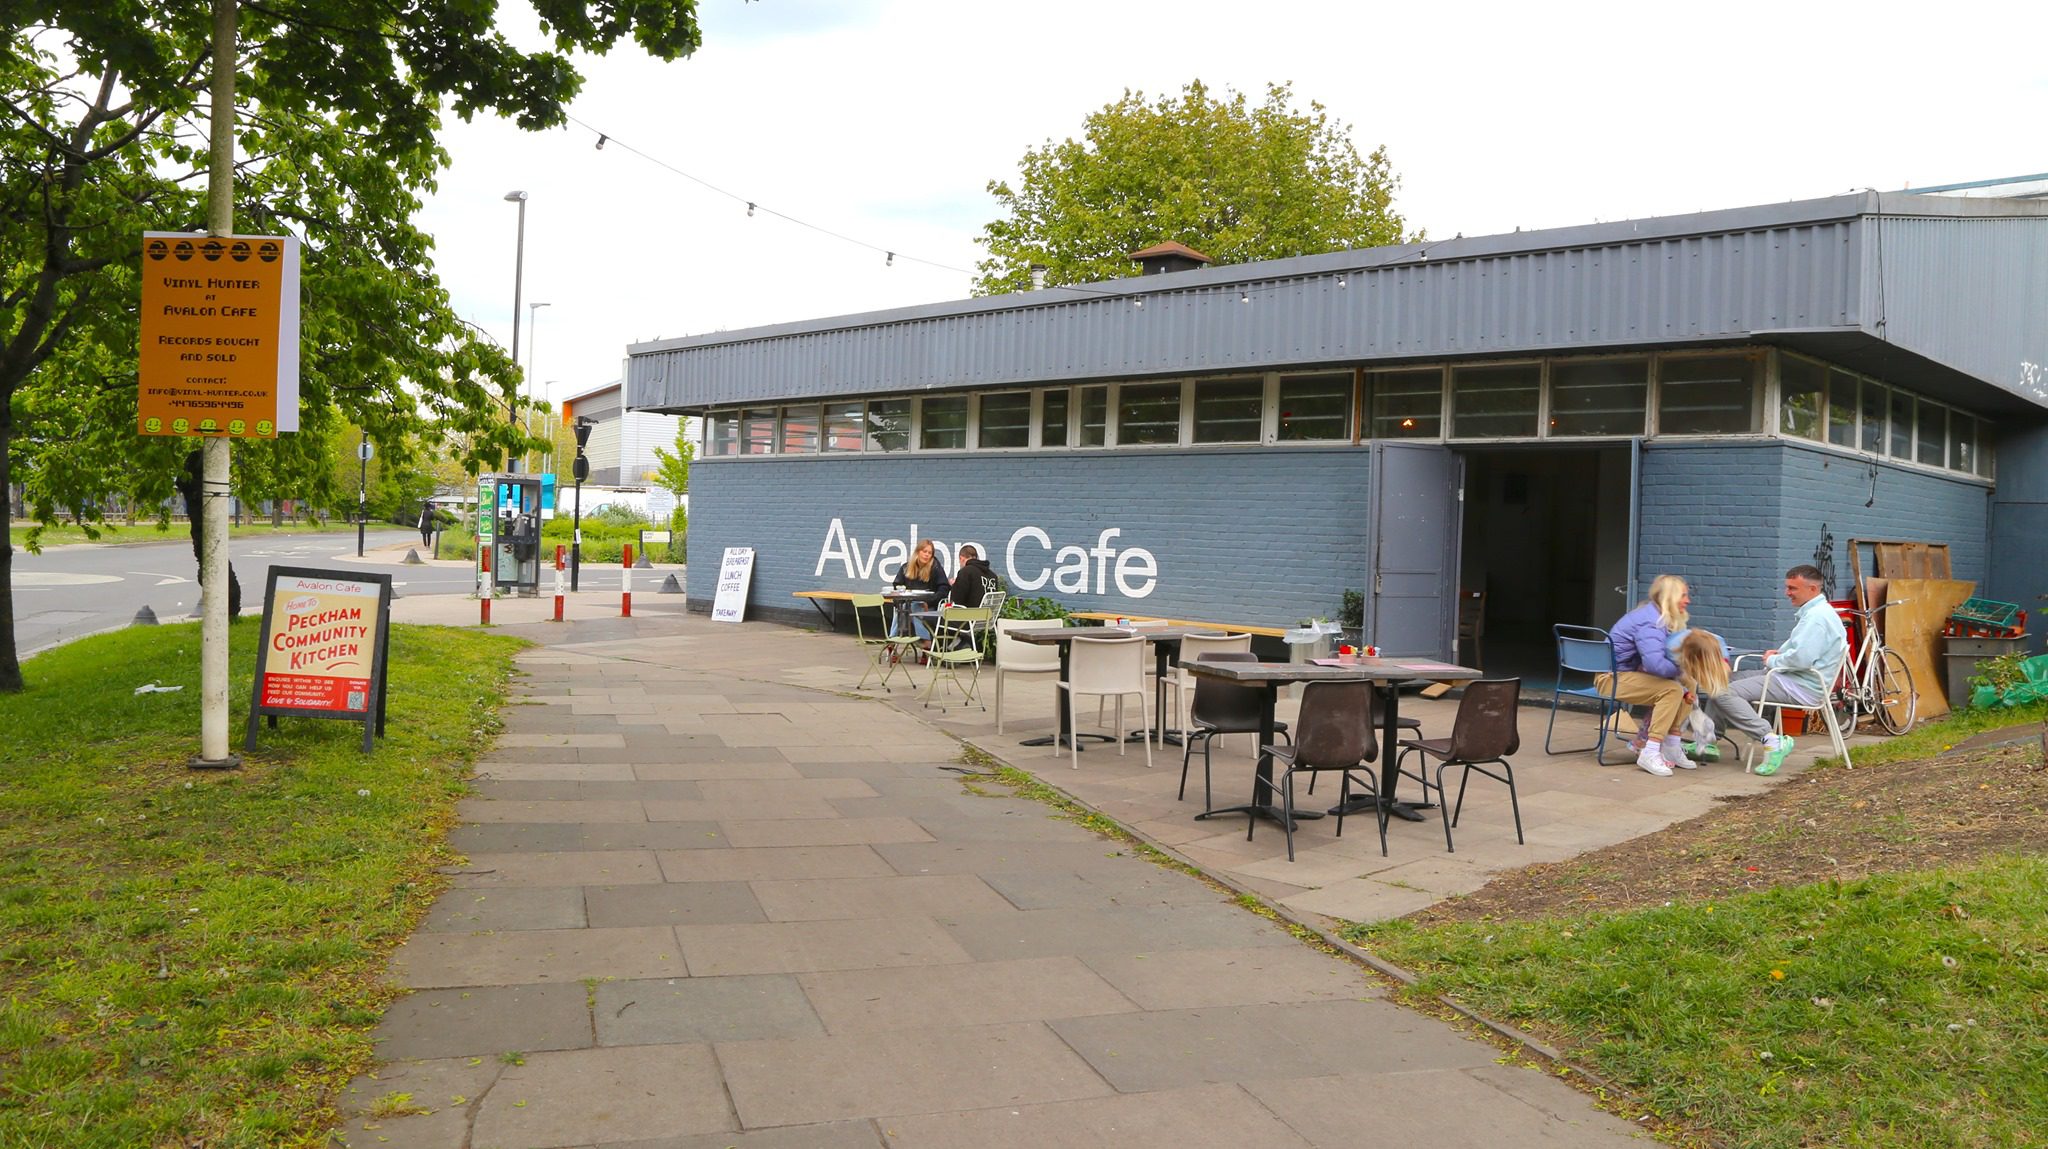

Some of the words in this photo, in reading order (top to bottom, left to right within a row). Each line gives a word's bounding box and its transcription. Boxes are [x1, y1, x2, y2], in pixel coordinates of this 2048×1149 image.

[163, 278, 203, 288] VINYL
[208, 278, 260, 289] HUNTER
[164, 305, 216, 316] AVALON
[221, 306, 257, 317] CAFE
[158, 336, 212, 346] RECORDS
[216, 337, 260, 347] BOUGHT
[180, 353, 203, 361] AND
[207, 353, 236, 362] SOLD
[1006, 526, 1157, 598] Cafe
[724, 570, 742, 580] LUNCH
[296, 580, 332, 591] Avalon
[335, 582, 361, 593] Cafe
[721, 582, 740, 592] COFFEE
[288, 608, 361, 632] PECKHAM
[273, 626, 368, 651] COMMUNITY
[290, 644, 358, 670] KITCHEN
